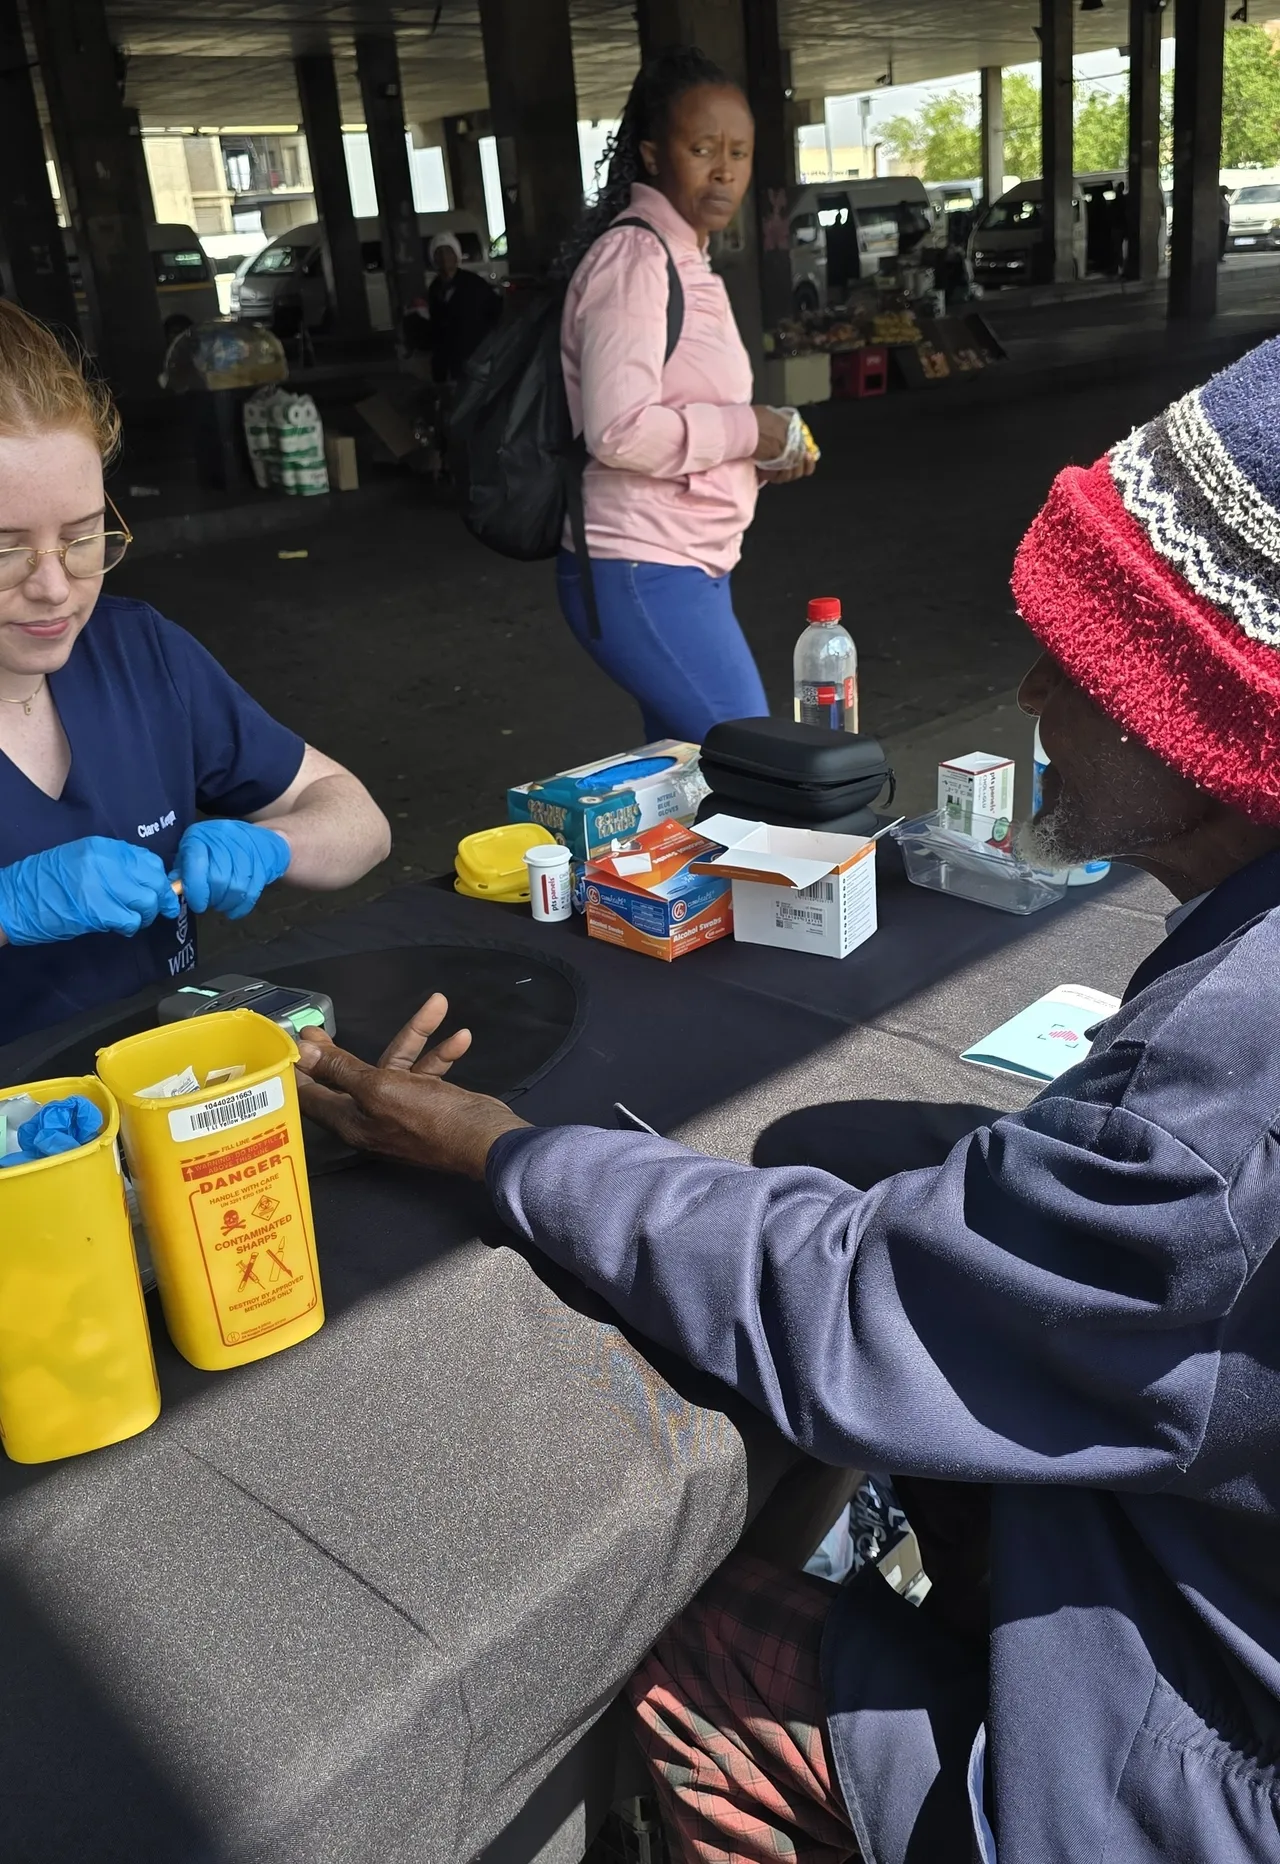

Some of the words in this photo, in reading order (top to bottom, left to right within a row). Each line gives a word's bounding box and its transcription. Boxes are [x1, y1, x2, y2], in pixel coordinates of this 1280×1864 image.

[595, 803, 640, 829] GOLDEN
[657, 801, 671, 810] BLUE
[658, 805, 679, 817] GLOVES
[137, 822, 160, 839] Clare
[598, 816, 637, 839] HANDS
[548, 877, 559, 900] panels
[551, 900, 559, 911] pts
[673, 925, 699, 942] Alcohol
[699, 917, 722, 932] Swabs
[168, 942, 195, 977] WITS
[204, 1090, 253, 1110] 10440231663
[220, 1118, 239, 1128] Yellow
[240, 1112, 257, 1122] Sharp
[221, 1142, 235, 1153] FILL
[235, 1137, 251, 1148] LINE
[235, 1149, 247, 1159] DO
[248, 1144, 264, 1153] NOT
[265, 1136, 280, 1147] FILL
[208, 1162, 235, 1174] ABOVE
[235, 1154, 252, 1165] THIS
[253, 1147, 270, 1158] LINE
[199, 1154, 282, 1194] DANGER
[209, 1190, 240, 1205] HANDLE
[240, 1182, 260, 1194] WITH
[260, 1173, 280, 1186] CARE
[214, 1214, 293, 1252] CONTAMINATED
[236, 1231, 278, 1254] SHARPS
[228, 1296, 260, 1312] DESTROY
[261, 1291, 271, 1300] BY
[271, 1275, 304, 1295] APPROVED
[244, 1296, 277, 1313] METHODS
[277, 1287, 294, 1299] ONLY
